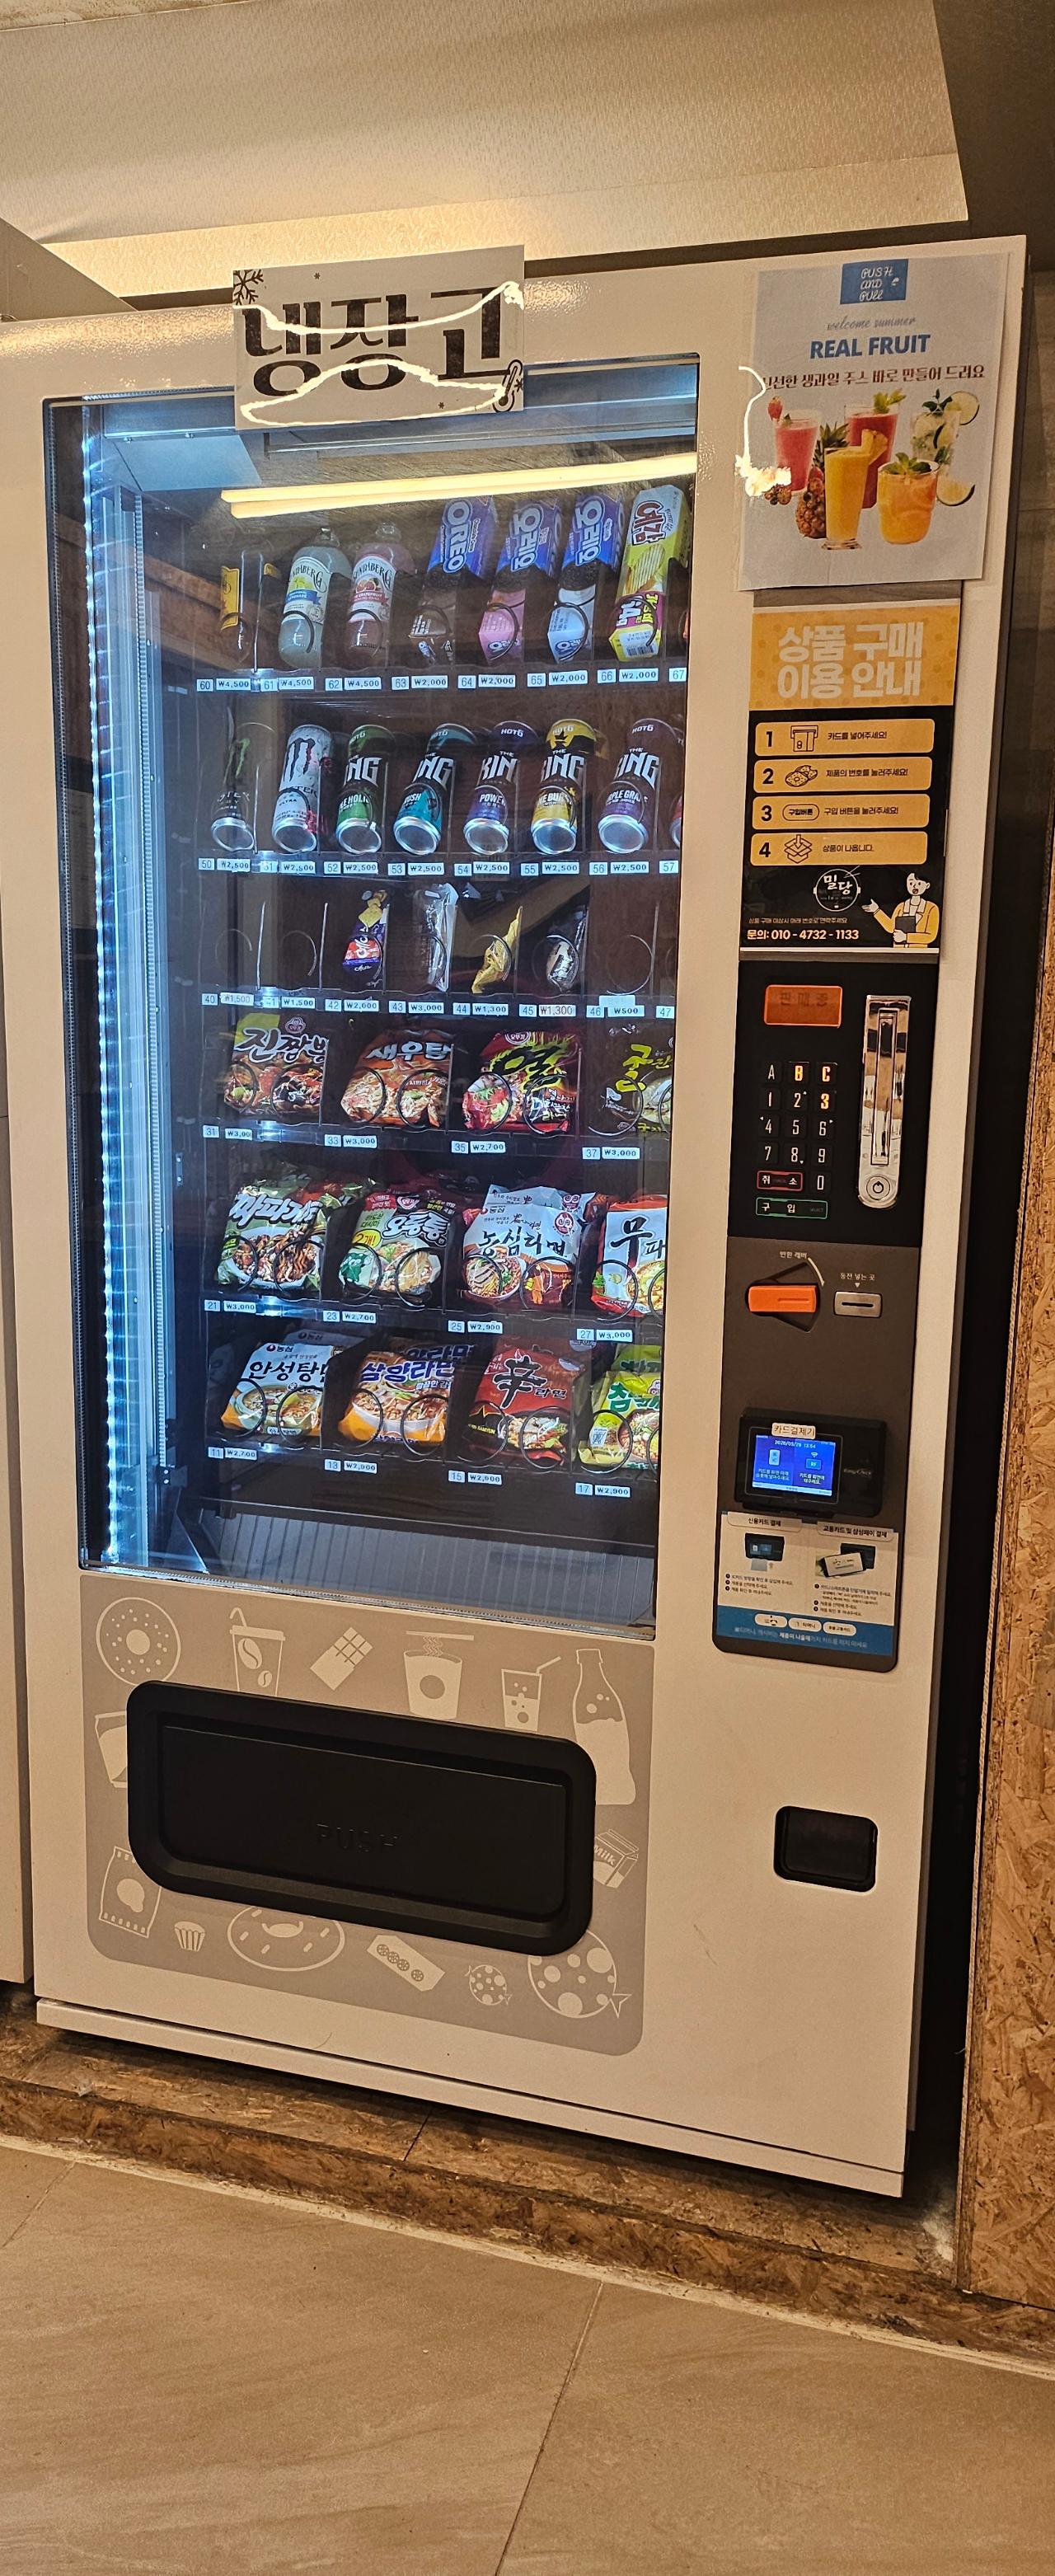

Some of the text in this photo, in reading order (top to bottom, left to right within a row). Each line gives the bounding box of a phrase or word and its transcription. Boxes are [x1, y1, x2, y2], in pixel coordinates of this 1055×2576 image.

[860, 266, 893, 279] PUSH
[828, 315, 917, 331] welcome summer
[242, 286, 509, 397] 냉장고
[810, 334, 931, 359] REAL FRUIT
[801, 364, 985, 387] 생과일 주스 바로 만들어 드려요
[447, 500, 470, 570] OREO
[574, 500, 603, 564] 오레오
[513, 506, 541, 570] 오레오
[778, 622, 923, 662] 상품 구매
[531, 675, 542, 684] 65
[601, 672, 613, 681] 66
[673, 670, 685, 679] 67
[777, 660, 921, 699] 이용 안내
[199, 681, 211, 689] 60
[264, 680, 275, 689] 61
[329, 679, 340, 689] 62
[395, 679, 406, 688] 63
[461, 678, 473, 687] 64
[766, 731, 772, 747] 1
[762, 768, 773, 784] 2
[761, 806, 772, 821] 3
[758, 843, 771, 857] 4
[201, 860, 212, 868] 50
[327, 863, 338, 872] 52
[663, 862, 674, 872] 57
[392, 866, 402, 874] 53
[457, 866, 468, 874] 54
[524, 866, 536, 874] 55
[593, 865, 604, 874] 56
[824, 875, 853, 895] 밀당
[747, 930, 859, 940] 문의: 010 4732 1133
[205, 995, 215, 1003] 40
[328, 1001, 339, 1010] 42
[392, 1002, 403, 1011] 43
[457, 1005, 467, 1014] 44
[523, 1006, 534, 1015] 45
[589, 1006, 601, 1016] 46
[660, 1007, 672, 1016] 47
[368, 1041, 450, 1059] 새우탕
[768, 1064, 831, 1082] A B C
[768, 1092, 829, 1110] 1 2 3
[765, 1119, 827, 1137] 4 5 6
[328, 1137, 340, 1145] 33
[455, 1143, 466, 1152] 35
[586, 1149, 598, 1158] 37
[765, 1146, 826, 1163] 7 8 9
[817, 1175, 824, 1190] 0
[384, 1213, 448, 1240] 오동통
[478, 1226, 566, 1257] 농심라면
[327, 1311, 338, 1319] 23
[451, 1323, 462, 1331] 25
[580, 1330, 592, 1340] 27
[277, 1344, 293, 1353] 농심
[535, 1387, 567, 1399] 라면
[774, 1426, 815, 1436] 카드결제기
[328, 1461, 339, 1469] 13
[579, 1485, 588, 1494] 17
[823, 1527, 846, 1535] 교통카드
[316, 1823, 399, 1853] PUSH
[593, 1845, 617, 1865] Milk
